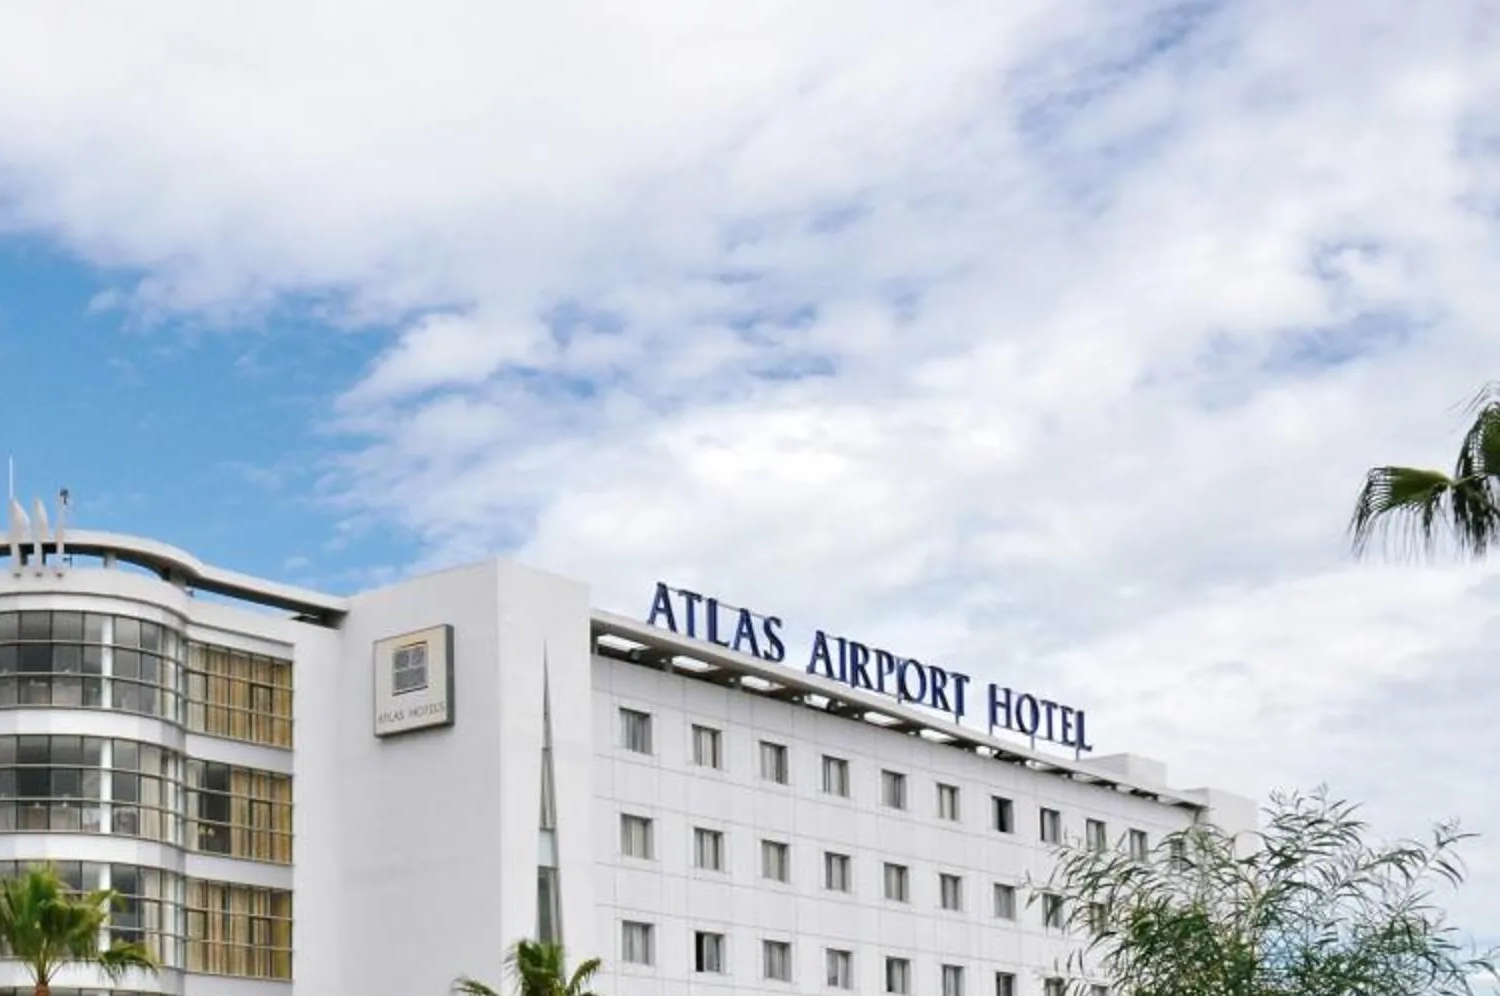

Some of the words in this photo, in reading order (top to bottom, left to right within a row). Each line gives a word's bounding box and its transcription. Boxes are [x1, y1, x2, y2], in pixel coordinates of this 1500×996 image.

[647, 581, 786, 662] ATLAS
[806, 629, 970, 718] AIRPORT
[987, 682, 1093, 752] HOTEL
